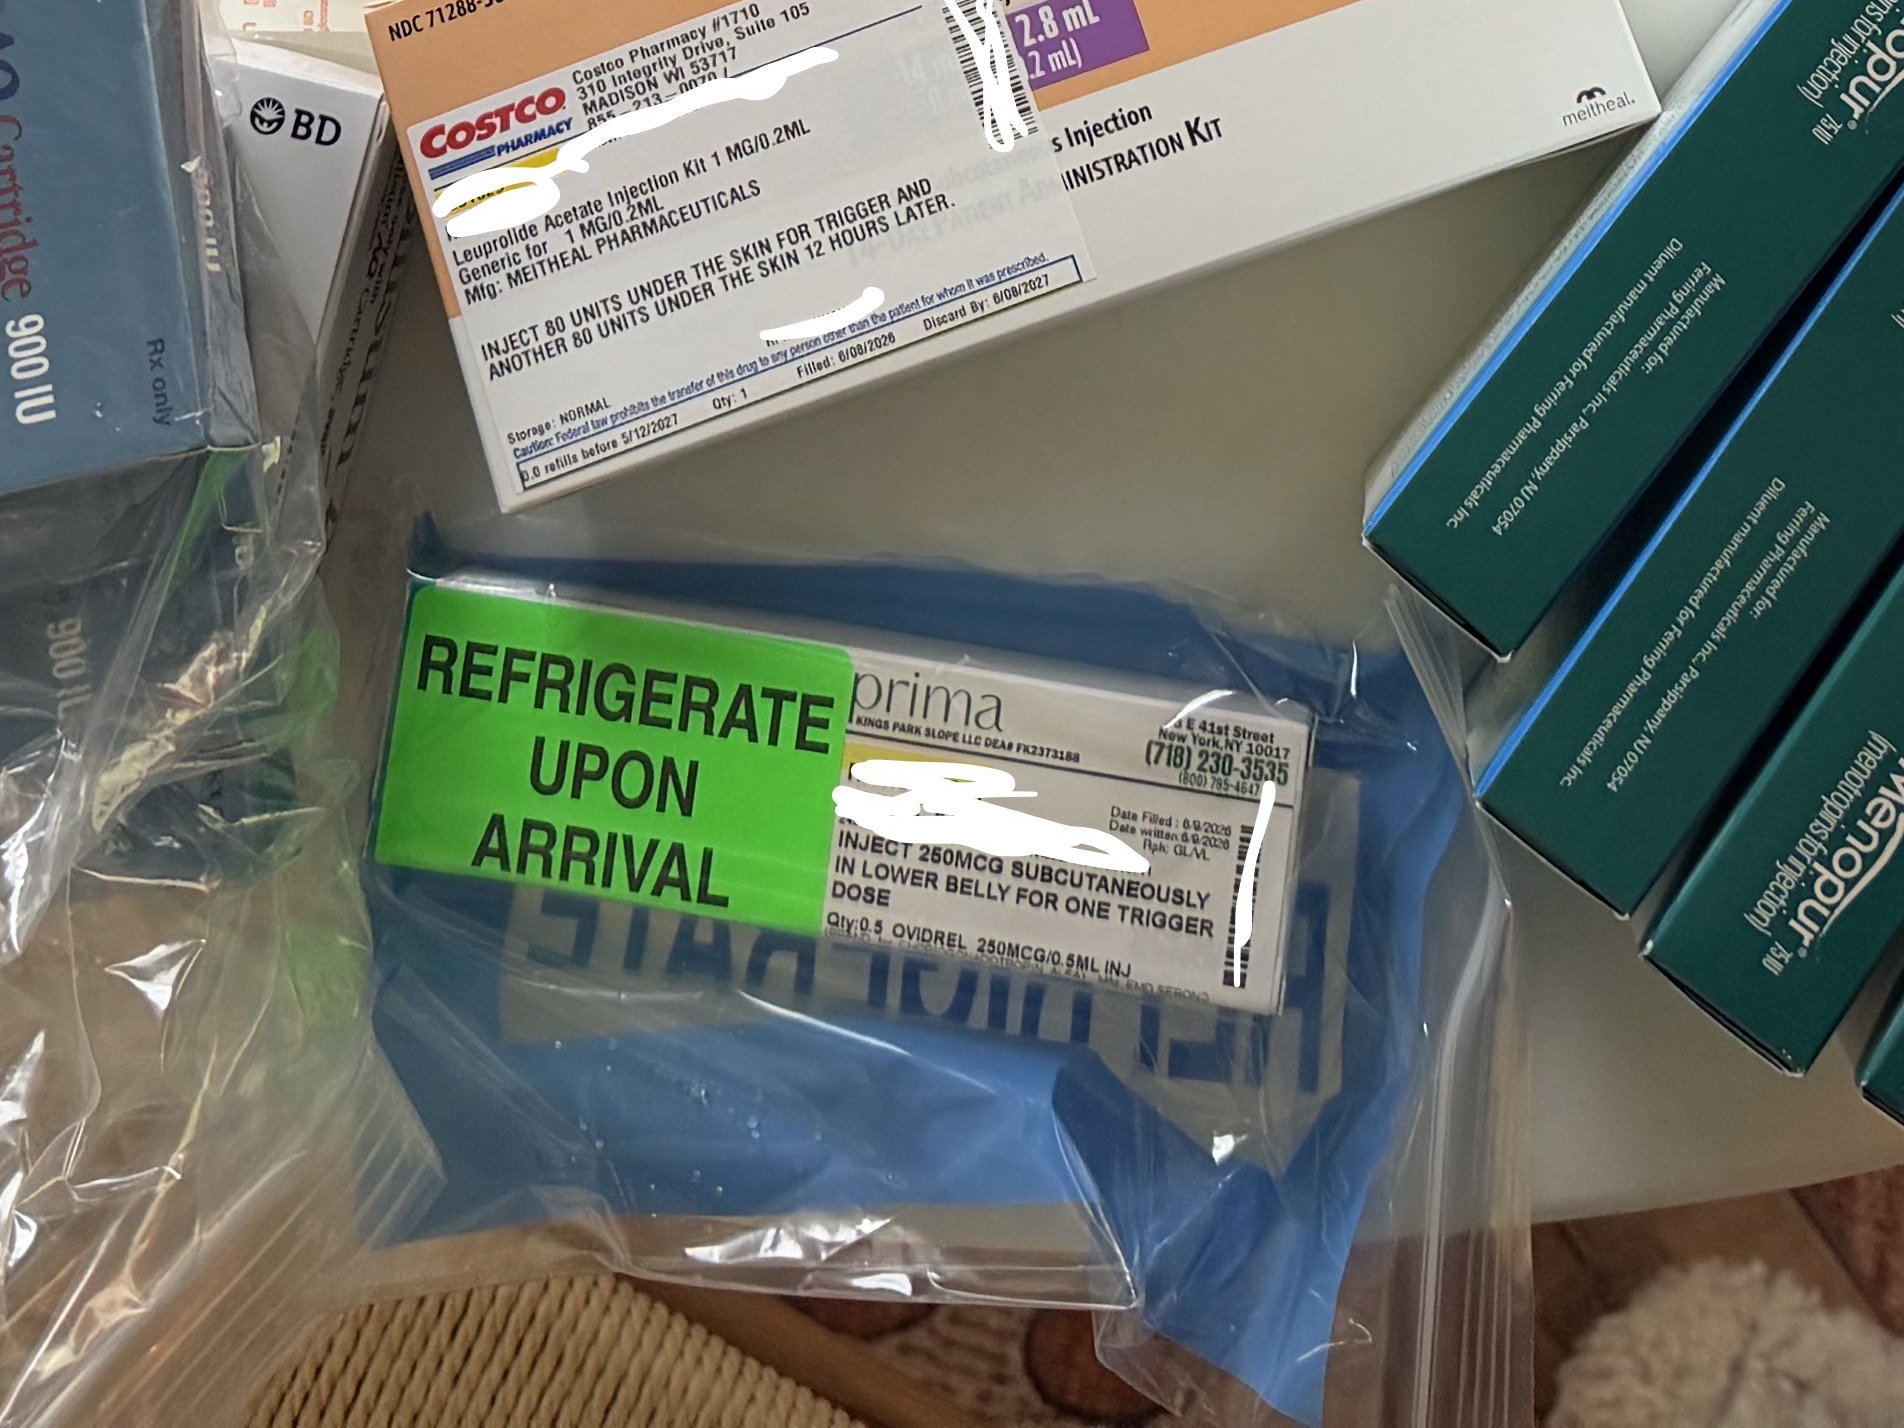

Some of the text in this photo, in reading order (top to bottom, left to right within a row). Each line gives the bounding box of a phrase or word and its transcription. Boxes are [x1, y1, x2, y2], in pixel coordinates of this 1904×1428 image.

[388, 14, 424, 42] NDC
[1015, 4, 1059, 46] 2.8
[290, 108, 343, 150] BD
[420, 86, 566, 160] COSTCO
[497, 117, 573, 157] PHARMACY
[1065, 103, 1153, 150] Injection
[452, 157, 708, 267] Leuprolide Acetate Injection Kit
[481, 178, 932, 362] INJECT 80 UNITS UNDER THE SKIN FOR TRIGGER AND
[4, 312, 50, 380] 900
[14, 382, 57, 426] IU
[146, 338, 172, 428] Rx only
[417, 633, 835, 755] REFRIGERATE
[850, 665, 1005, 736] prima
[529, 735, 700, 818] UPON
[470, 813, 729, 908] ARRIVAL
[838, 829, 1211, 911] INJECT 250MCG SUBCUTANEOUSLY
